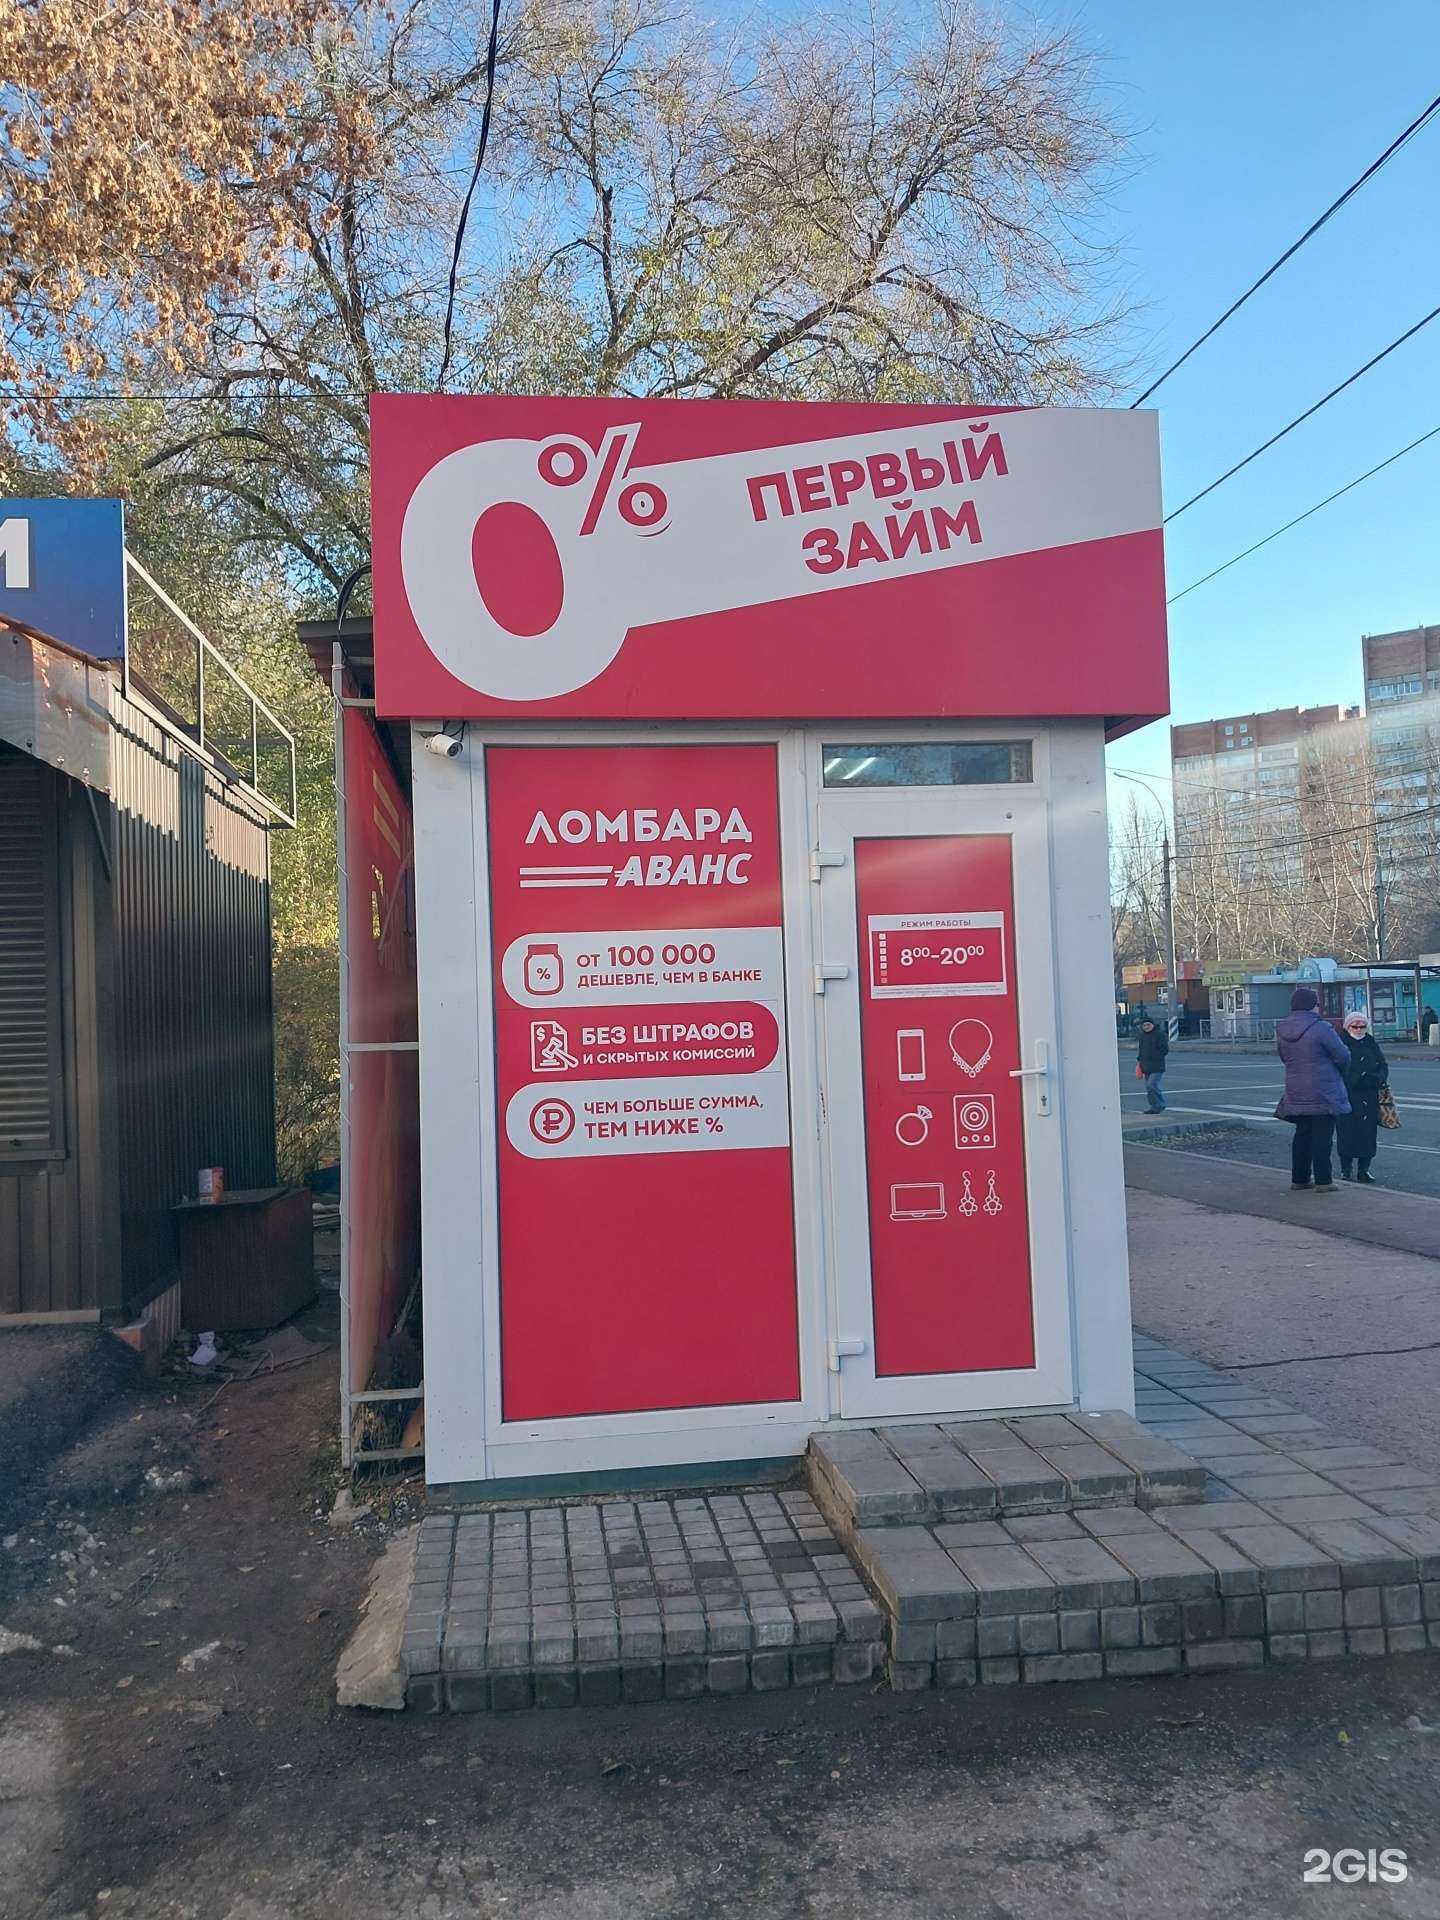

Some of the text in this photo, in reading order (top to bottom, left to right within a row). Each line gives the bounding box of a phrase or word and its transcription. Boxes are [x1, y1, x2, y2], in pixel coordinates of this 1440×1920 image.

[746, 422, 1009, 522] ПЕРВЫЙ
[802, 498, 983, 575] ЗАЙМ
[524, 807, 753, 845] ЛОМБАРД
[614, 852, 753, 887] АВАНС
[900, 919, 971, 929] РЕЖИМ РАБОТЫ
[607, 944, 655, 967] 100
[661, 943, 717, 966] 000
[577, 969, 763, 988] ДЕШЕВЛЕ, ЧЕМ В БАНКЕ
[581, 1021, 755, 1046] БЕЗ ШТРАФОВ
[583, 1044, 756, 1065] И СКРЫТЫХ КОМИССИЙ
[583, 1094, 764, 1115] ЧЕМ БОЛЬШЕ СУММА,
[584, 1116, 724, 1139] ТЕМ НИЖЕ %
